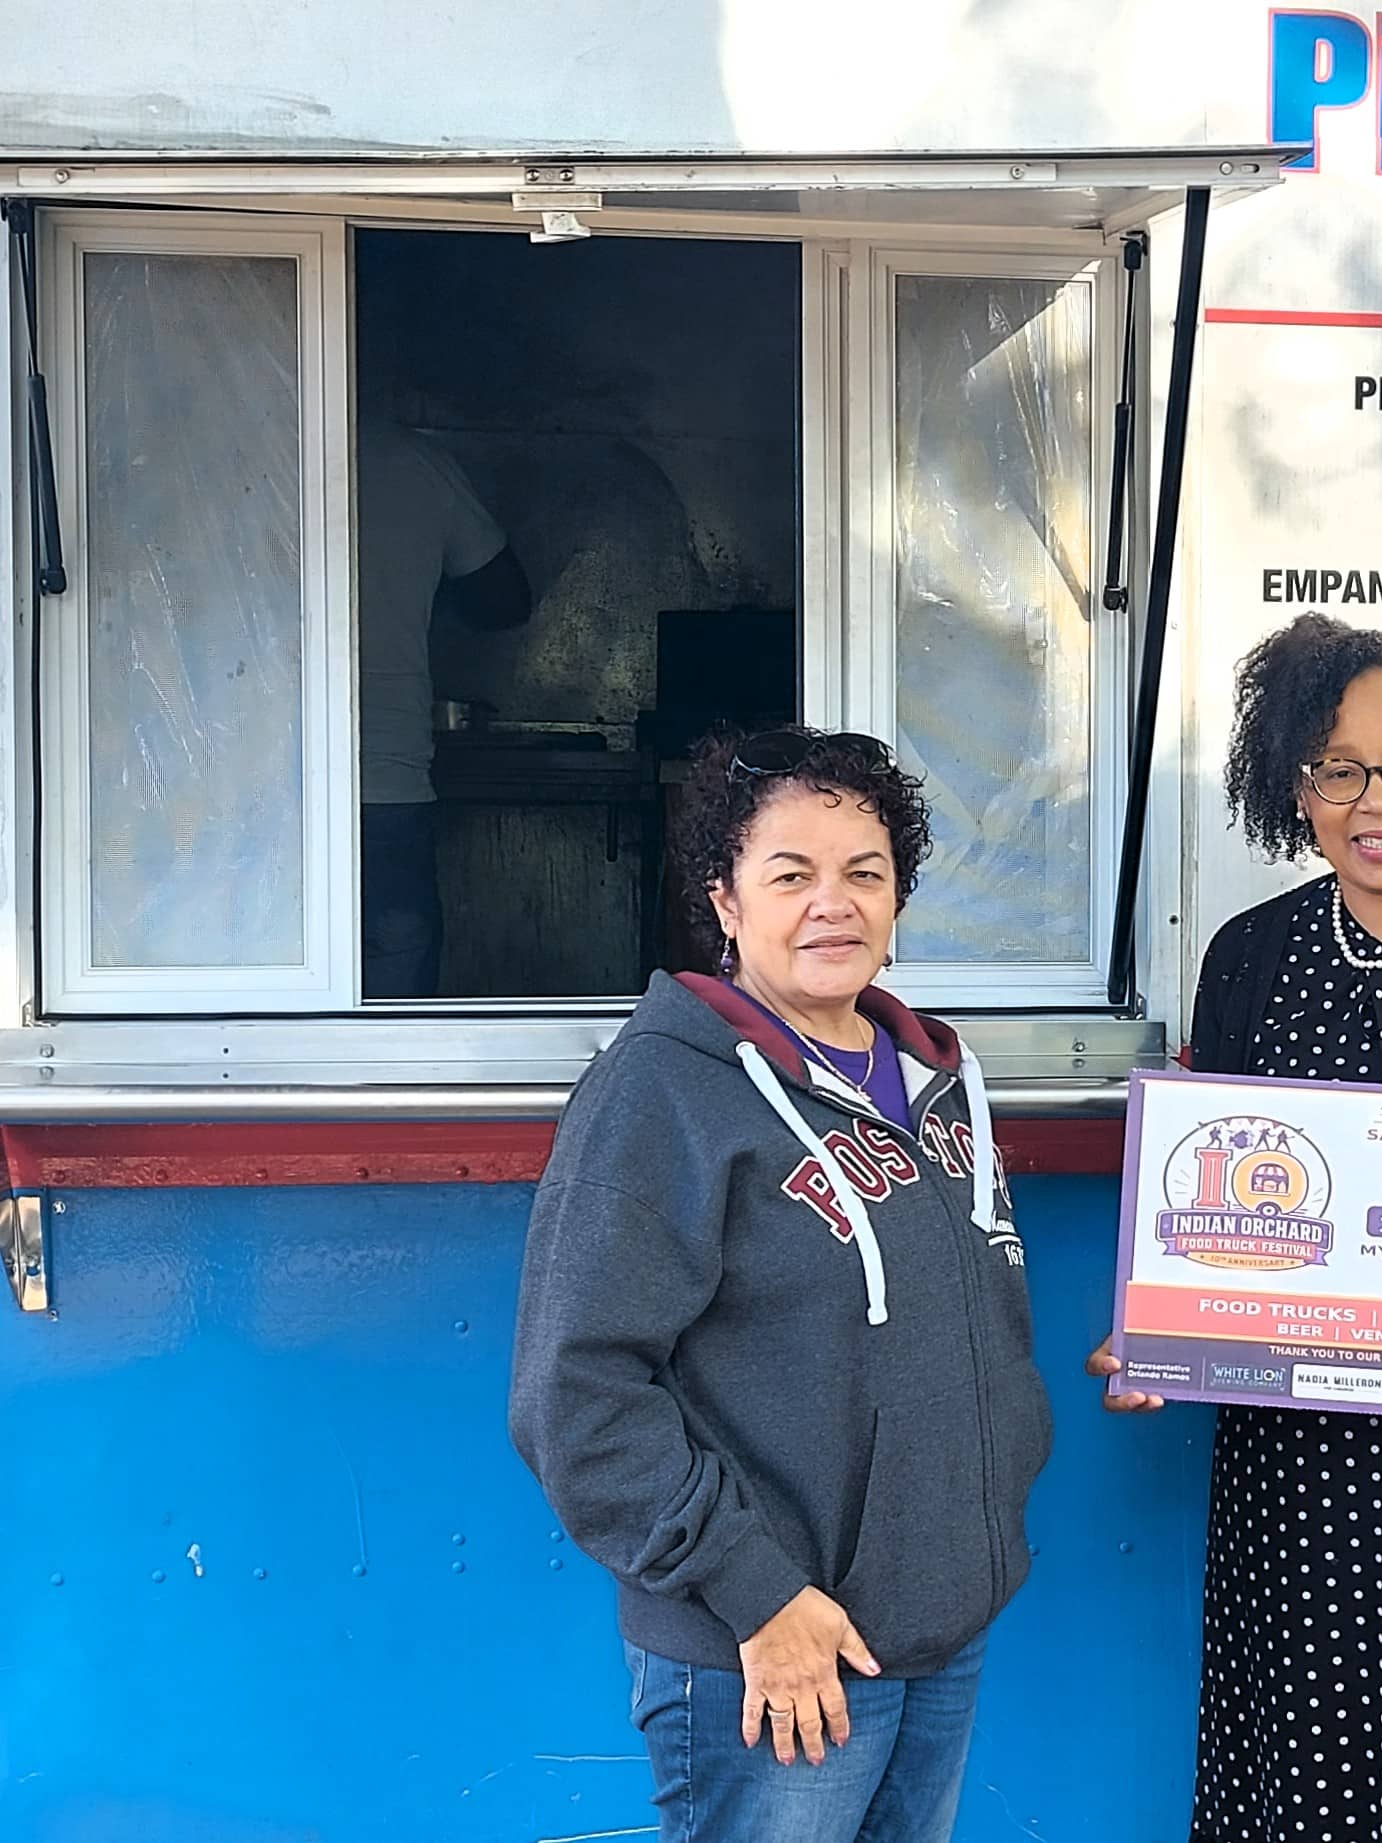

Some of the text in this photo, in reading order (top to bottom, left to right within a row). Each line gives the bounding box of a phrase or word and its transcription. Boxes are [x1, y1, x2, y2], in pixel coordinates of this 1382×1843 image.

[1171, 1214, 1322, 1243] INDIAN ORCHARD
[1181, 1237, 1313, 1258] FOOD TRUCK FESTIVAL
[1199, 1298, 1262, 1316] FOOD
[1268, 1303, 1358, 1323] TRUCKS
[1276, 1323, 1324, 1338] BEER
[1268, 1345, 1309, 1358] THANK
[1311, 1348, 1336, 1360] YOU
[1337, 1349, 1353, 1361] TO
[1355, 1351, 1381, 1363] OUR
[1213, 1365, 1284, 1383] WHITE LION
[1297, 1373, 1382, 1389] NADIA MILLERON
